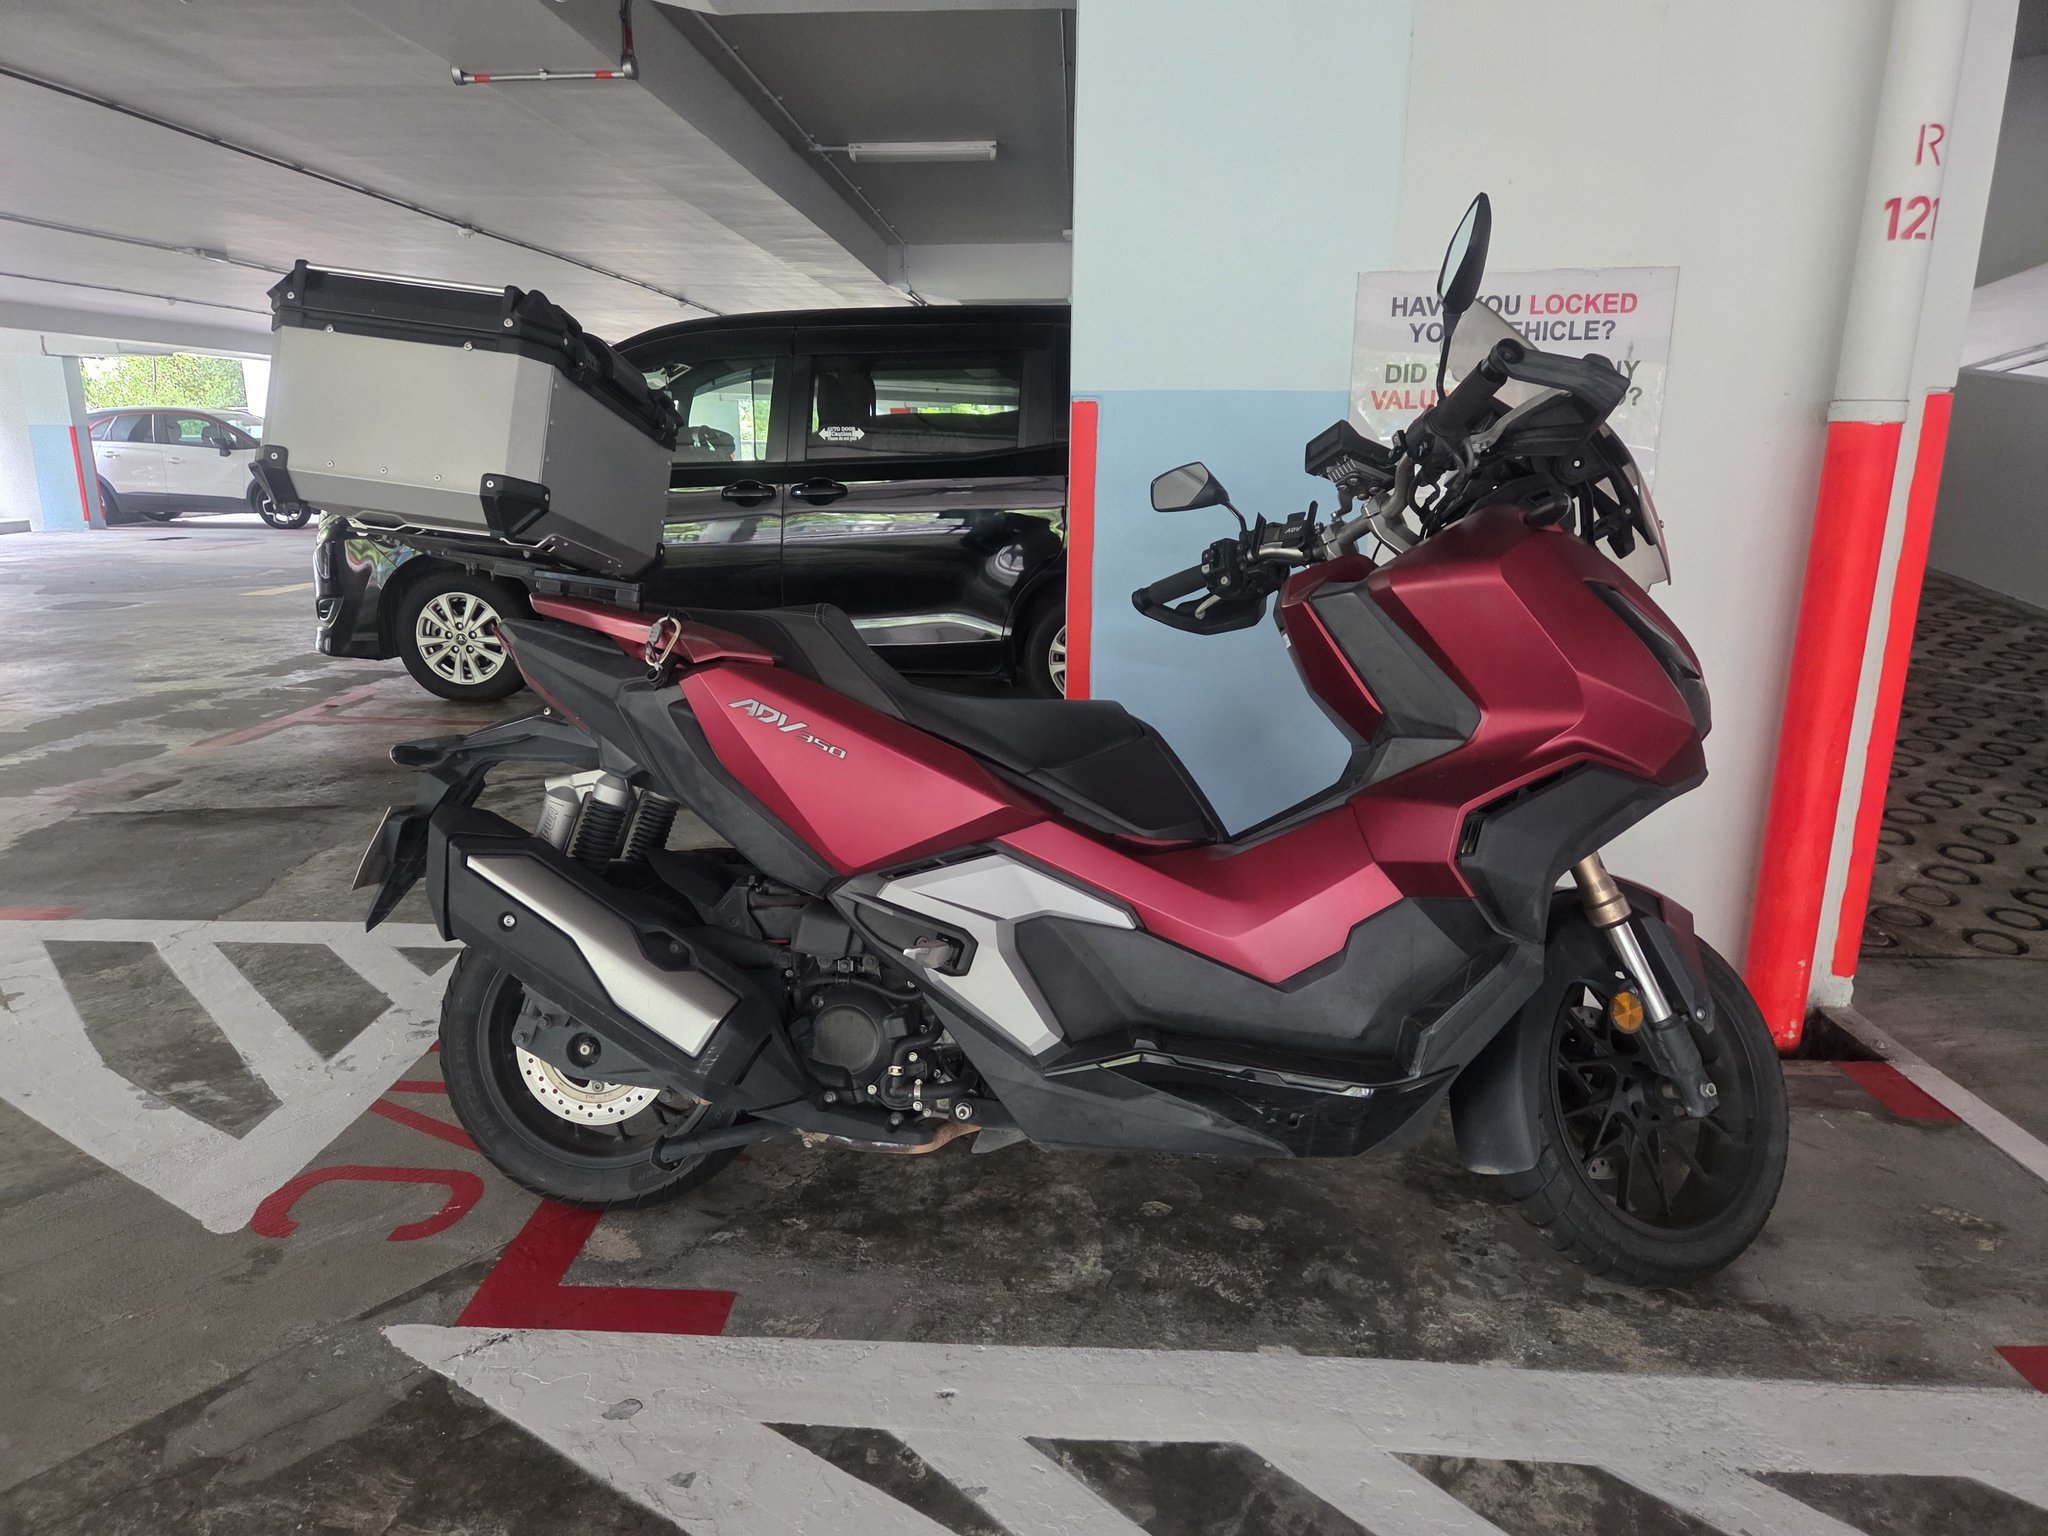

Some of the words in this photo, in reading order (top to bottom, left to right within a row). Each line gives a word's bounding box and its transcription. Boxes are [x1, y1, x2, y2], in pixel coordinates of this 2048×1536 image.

[1915, 123, 1945, 166] R
[1884, 195, 1940, 241] 121
[1391, 295, 1445, 317] HAV
[1477, 294, 1522, 316] OU
[1529, 292, 1638, 316] LOCKED
[1409, 322, 1446, 343] YO
[1508, 319, 1616, 341] HICLE?
[1385, 363, 1428, 384] DID
[1371, 389, 1446, 410] VALU
[728, 698, 808, 732] ADV
[798, 731, 847, 759] 350
